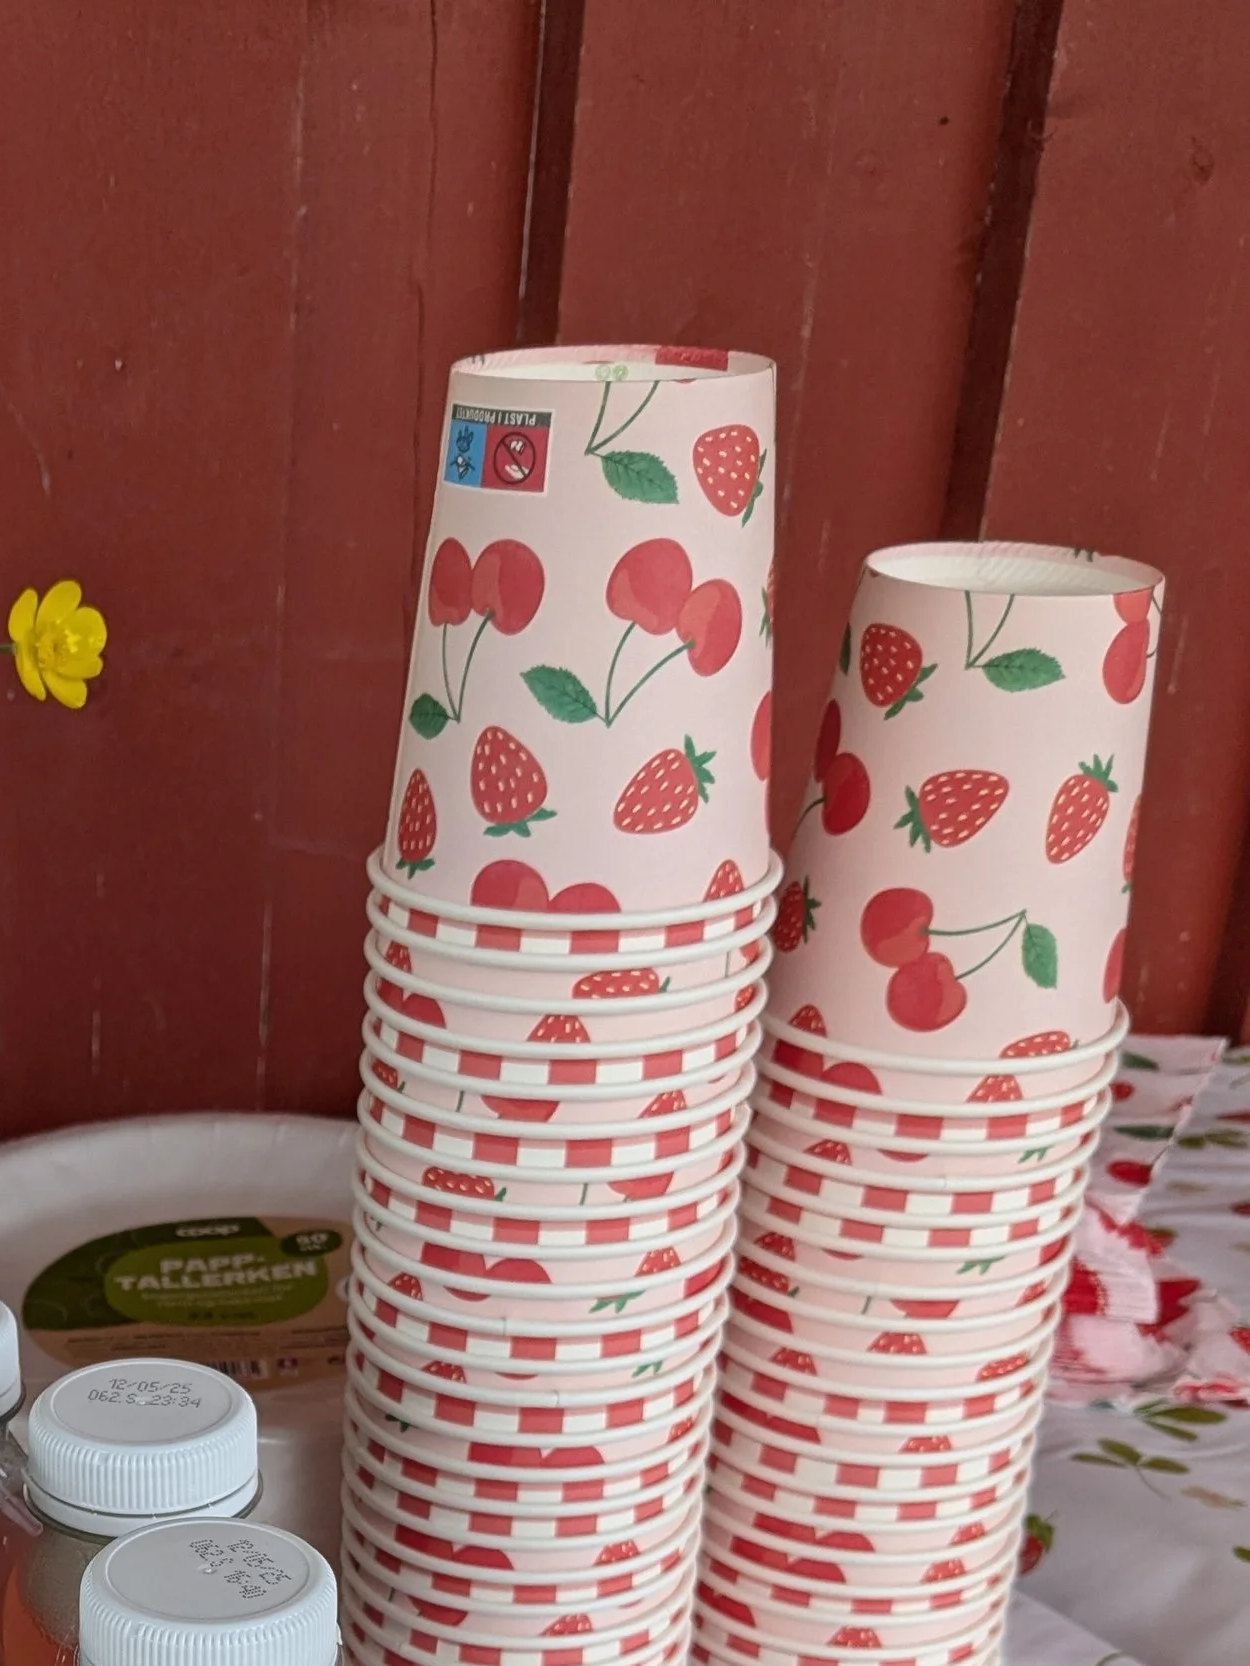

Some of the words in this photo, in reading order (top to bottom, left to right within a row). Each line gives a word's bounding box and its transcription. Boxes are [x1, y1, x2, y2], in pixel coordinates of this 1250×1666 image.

[497, 411, 503, 425] I
[504, 411, 538, 427] PLAST
[113, 1262, 317, 1291] TALLERKEN
[110, 1379, 191, 1394] 12/05/25
[150, 1395, 201, 1408] 23:34
[227, 1539, 291, 1585] 12/05/25
